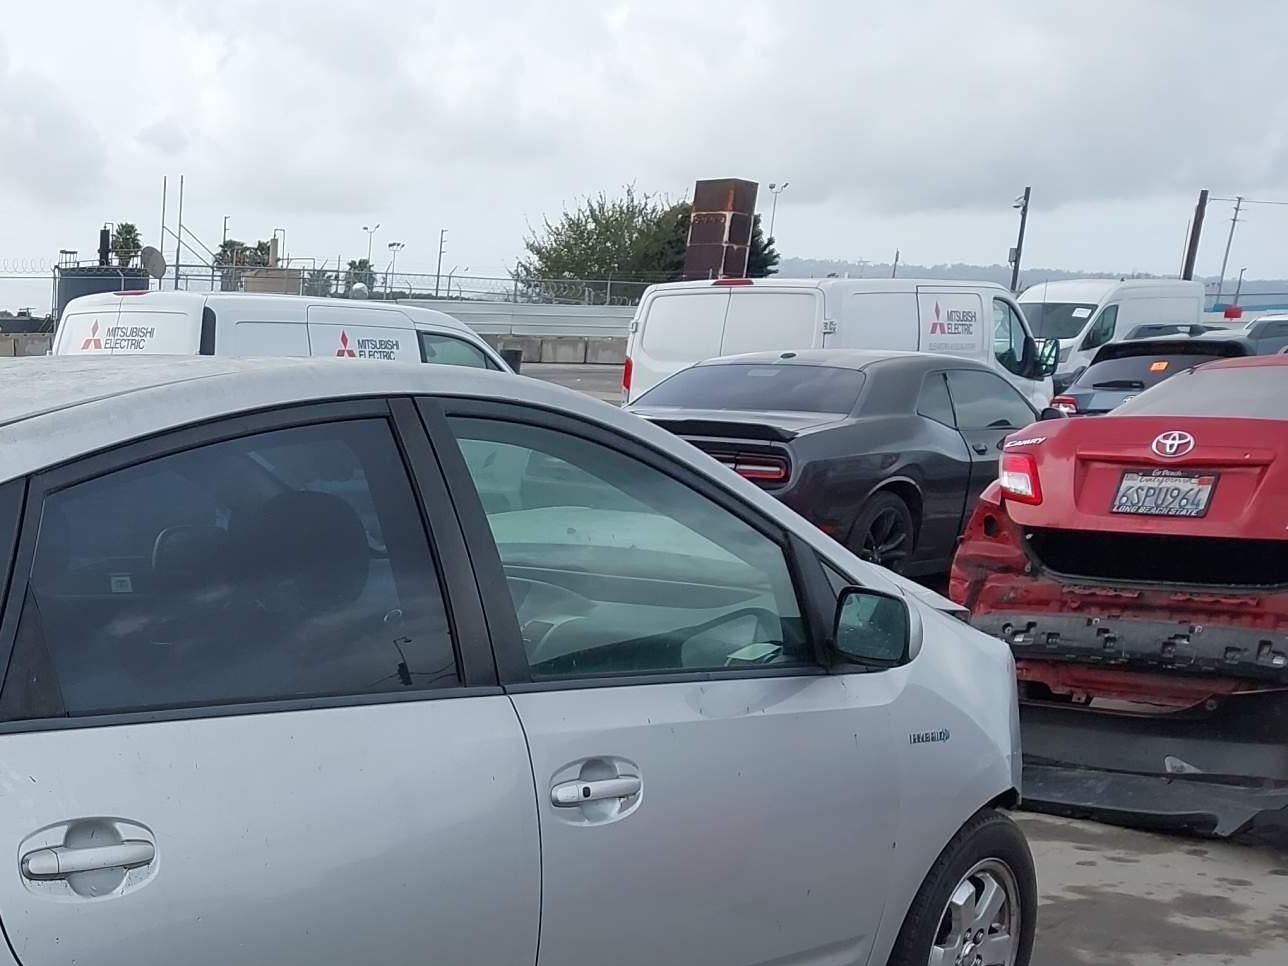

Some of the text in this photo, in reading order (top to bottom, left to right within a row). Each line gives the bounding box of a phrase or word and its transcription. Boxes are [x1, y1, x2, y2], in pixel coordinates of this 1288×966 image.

[106, 327, 155, 338] MITSUBISHI
[946, 323, 973, 335] ELECTRIC
[104, 338, 146, 350] ELECTRIC
[357, 339, 400, 350] MITSUBISHI
[358, 350, 396, 360] ELECTRIC
[1005, 436, 1047, 448] CAMRY
[1119, 486, 1203, 510] 6SPU964
[1140, 506, 1168, 514] BEACH
[1169, 508, 1199, 516] STATE
